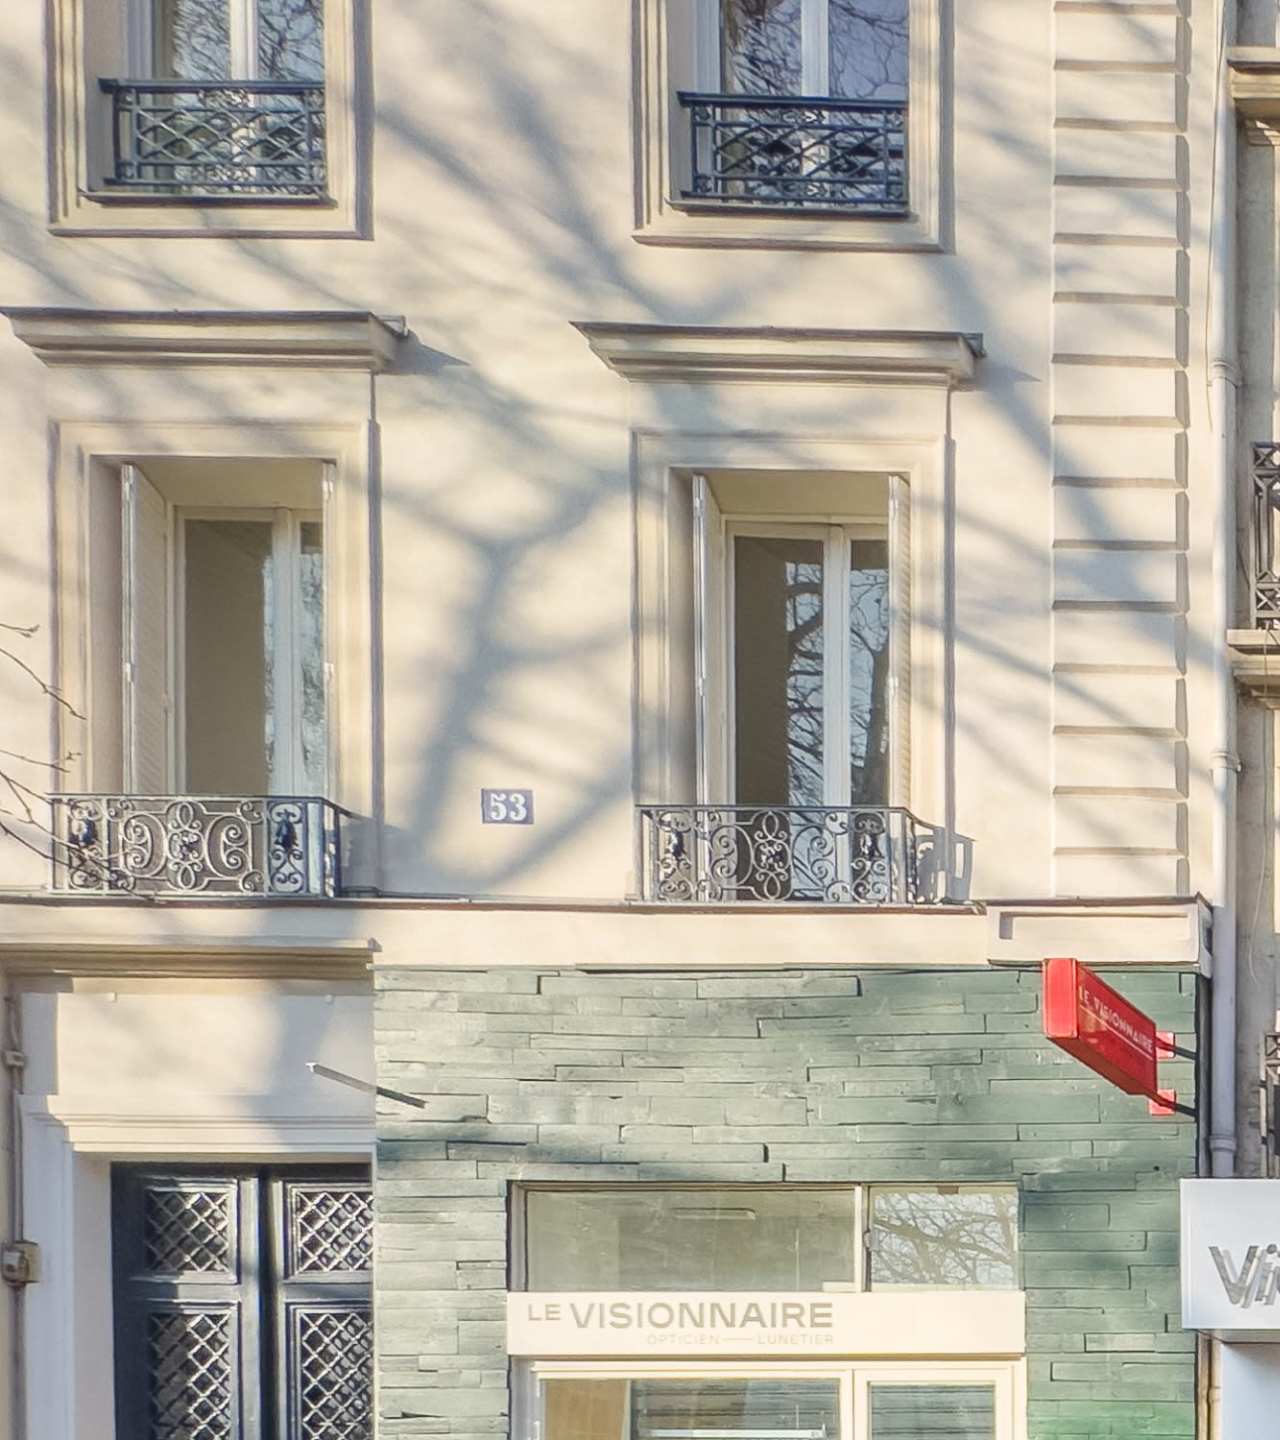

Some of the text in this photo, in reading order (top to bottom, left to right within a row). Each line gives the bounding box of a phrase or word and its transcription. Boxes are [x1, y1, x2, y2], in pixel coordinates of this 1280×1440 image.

[490, 793, 527, 820] 53
[1079, 985, 1091, 1009] LE
[528, 1302, 834, 1329] LE VISIONNAIRE
[647, 1333, 835, 1345] OPTICIEN LUNETIER
